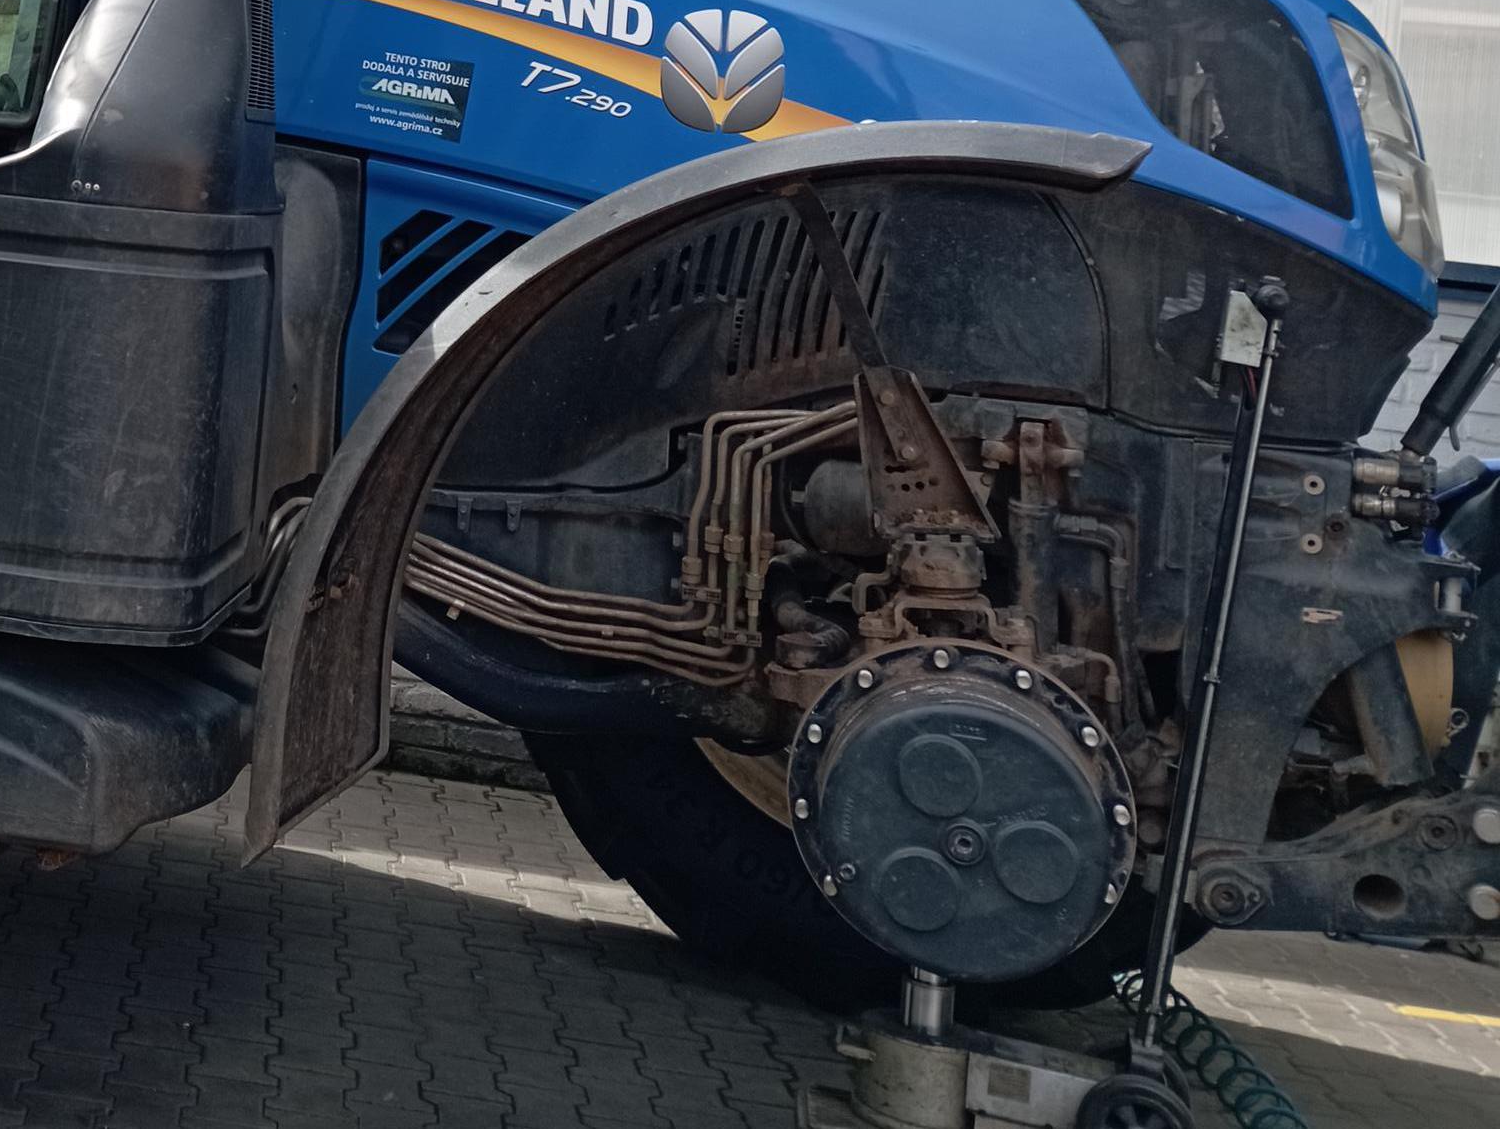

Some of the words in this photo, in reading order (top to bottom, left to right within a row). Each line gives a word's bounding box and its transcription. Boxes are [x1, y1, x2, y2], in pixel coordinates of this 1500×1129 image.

[362, 60, 404, 76] DODALA
[405, 68, 415, 78] A
[416, 69, 470, 88] SERVISUJE
[384, 52, 418, 66] TENTO
[419, 58, 451, 72] STROJ
[521, 61, 633, 119] T7.290
[369, 114, 443, 136] www.agrima.cz
